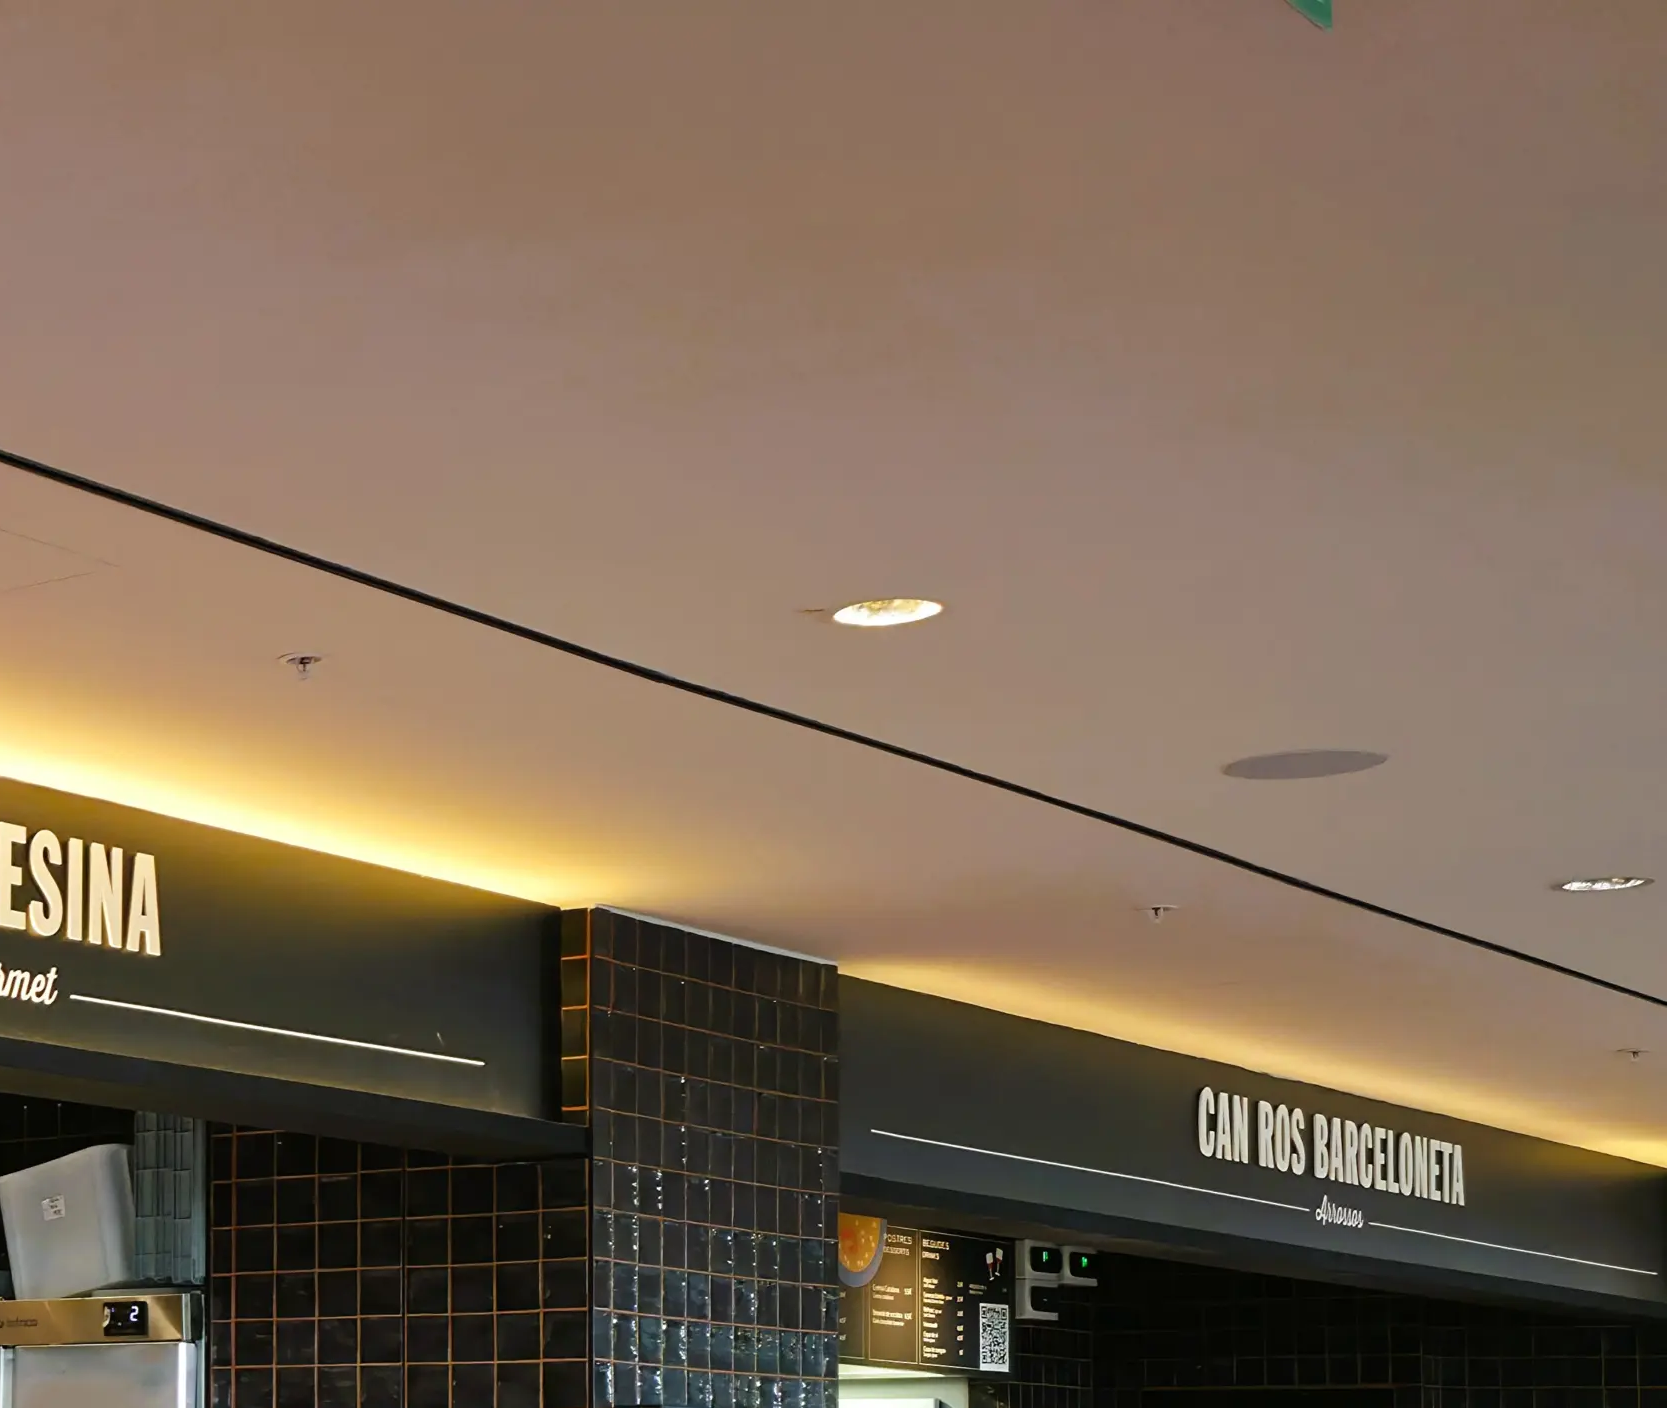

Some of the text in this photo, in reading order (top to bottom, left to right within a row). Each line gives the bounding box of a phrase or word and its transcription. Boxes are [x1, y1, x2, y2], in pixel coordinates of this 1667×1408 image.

[1198, 1086, 1465, 1206] CAN ROS BARCELONETA
[1315, 1194, 1365, 1229] Arrossos
[129, 1306, 139, 1322] 2
